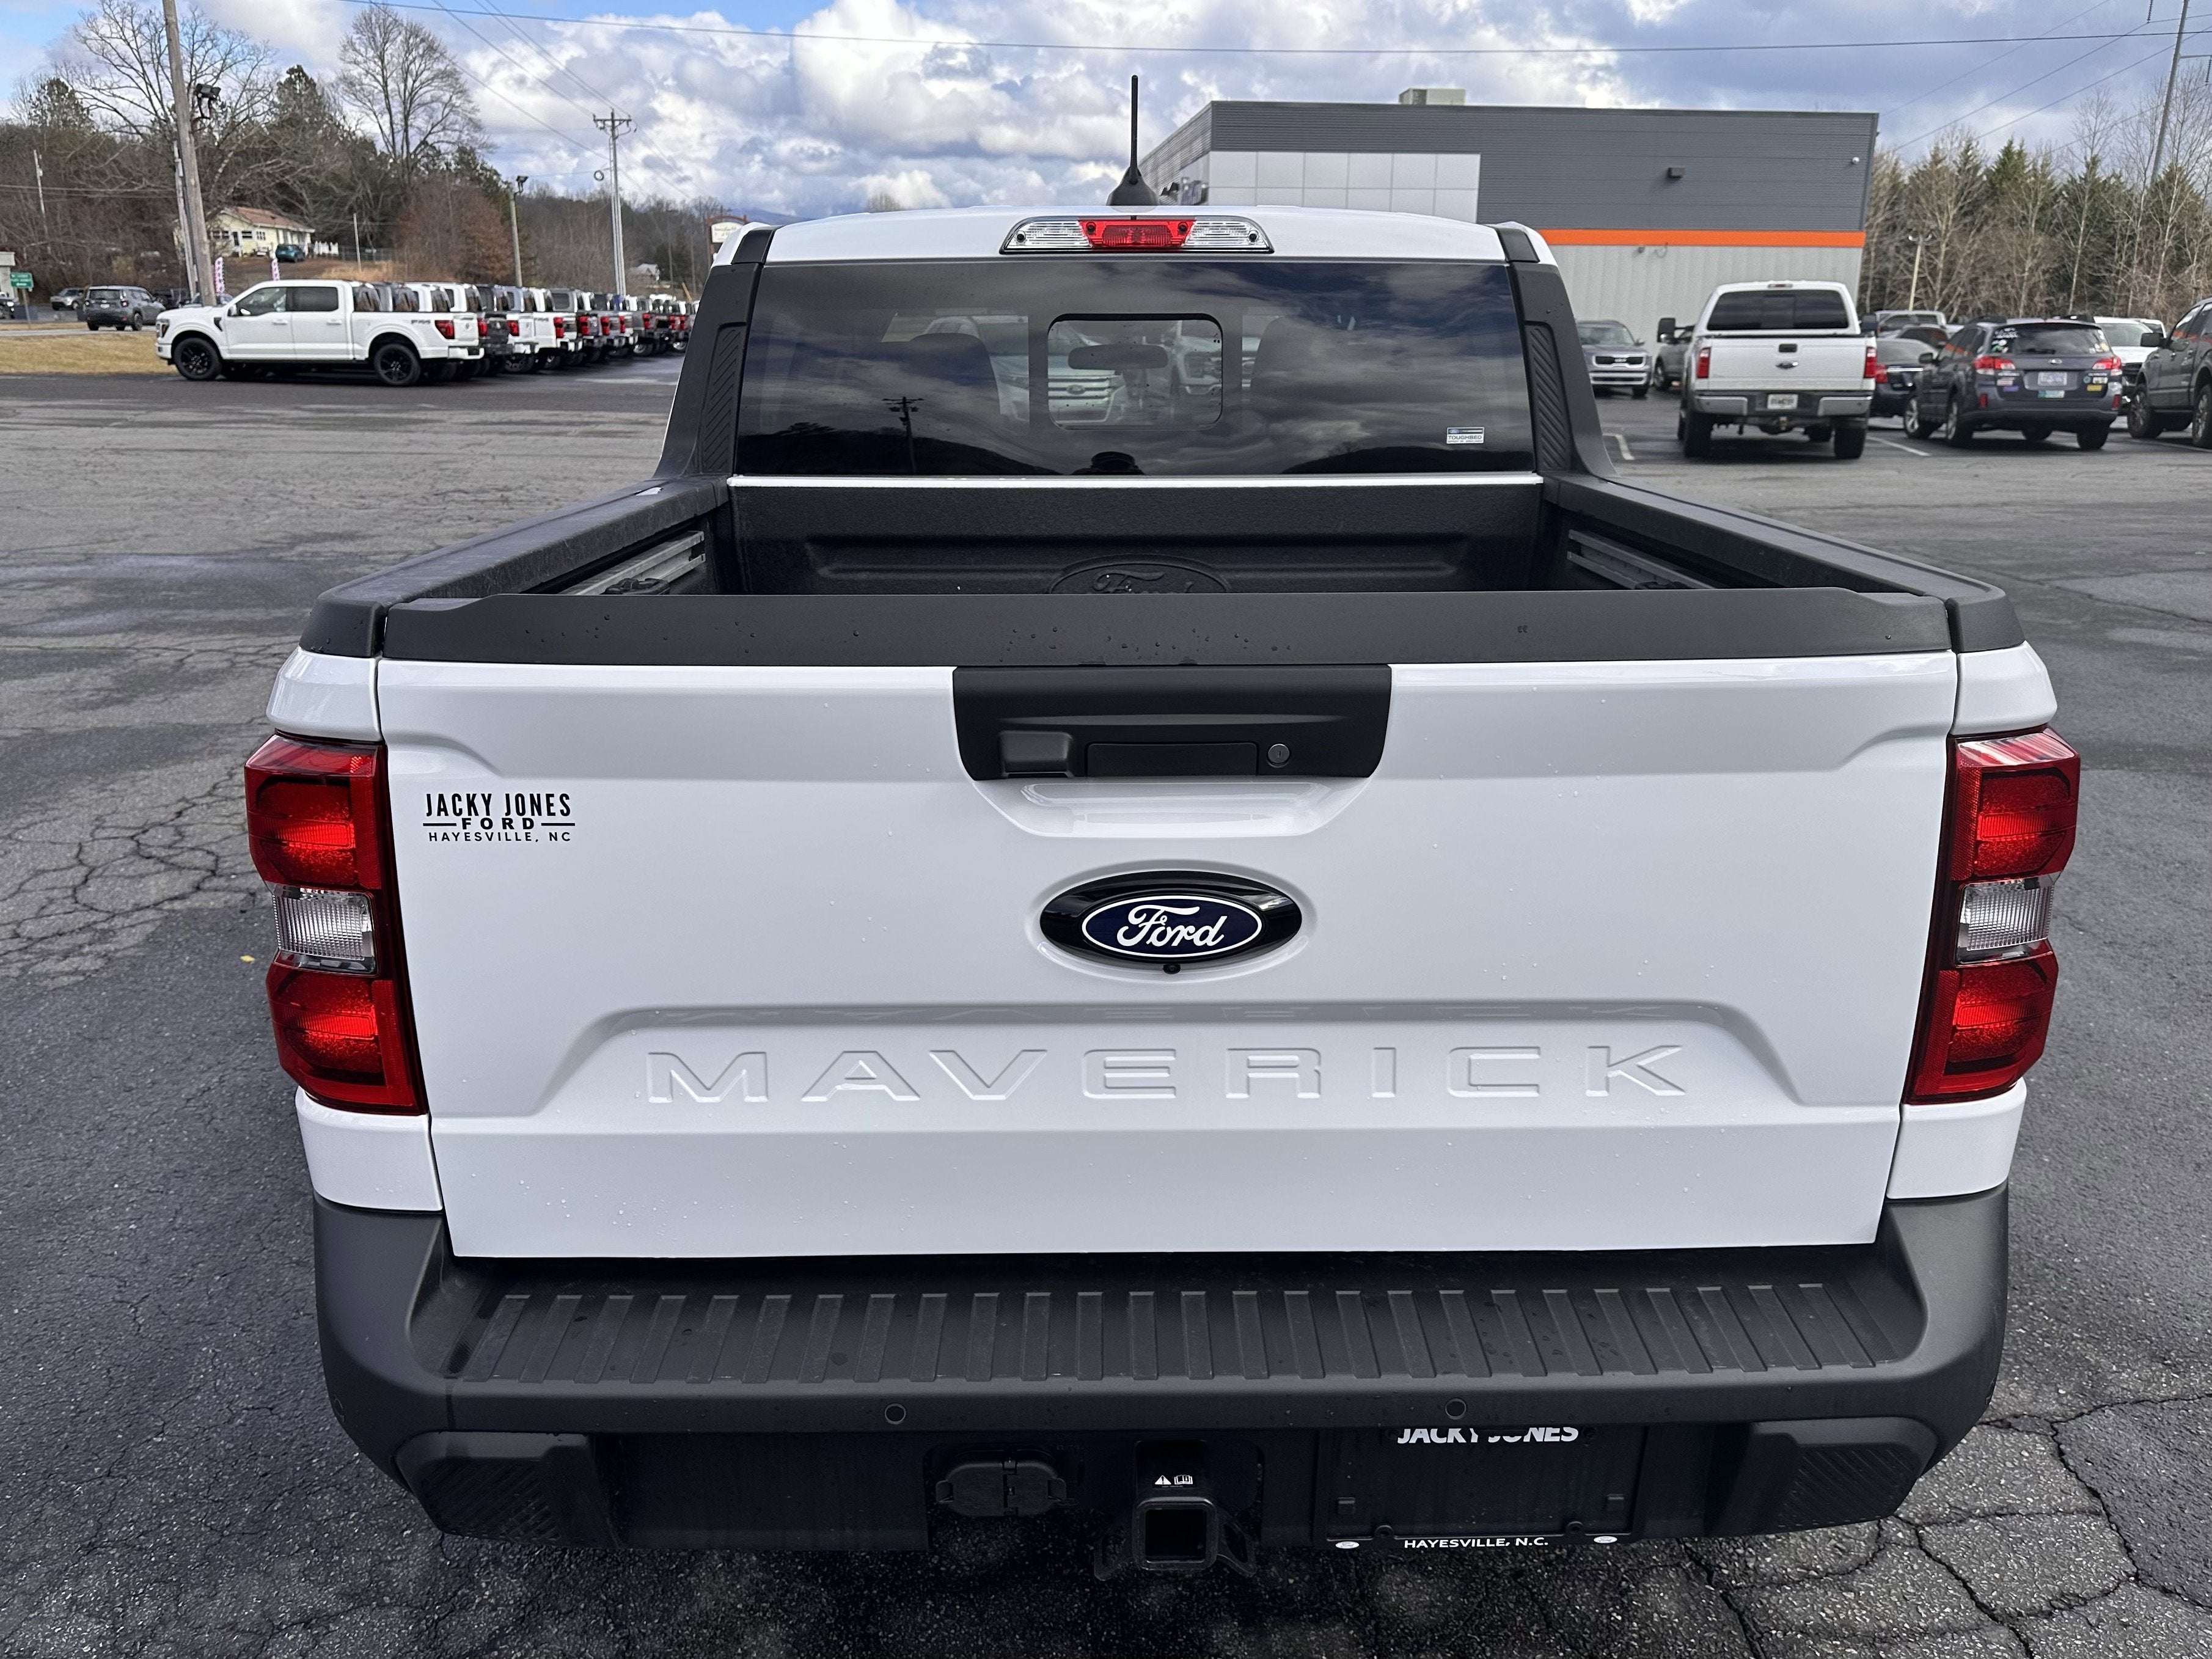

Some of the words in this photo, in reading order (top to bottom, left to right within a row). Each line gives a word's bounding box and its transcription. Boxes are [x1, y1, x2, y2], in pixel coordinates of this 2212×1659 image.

[426, 793, 493, 817] JACKY
[505, 793, 571, 817] JONES
[461, 817, 535, 830] FORD
[428, 832, 539, 843] HAYESVILLE,
[549, 832, 571, 841] NC
[1117, 904, 1228, 947] Ford
[648, 1046, 1685, 1102] MAVERICK
[1404, 1538, 1511, 1548] HAYESVILLE,
[1515, 1537, 1548, 1546] N.C.
